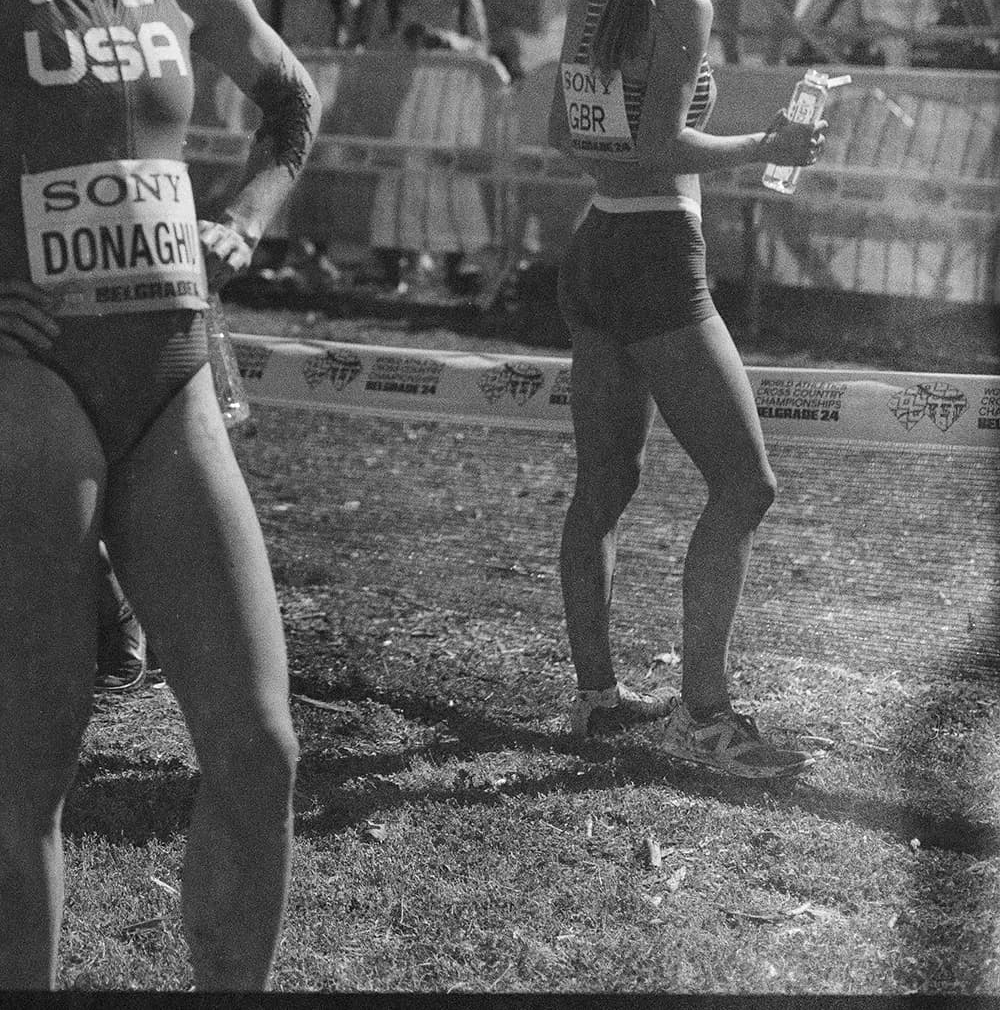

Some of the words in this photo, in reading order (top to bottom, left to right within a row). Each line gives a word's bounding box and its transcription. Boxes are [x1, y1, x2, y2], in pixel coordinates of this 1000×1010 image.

[24, 21, 188, 85] USA
[564, 71, 613, 94] SONY
[569, 103, 606, 133] GBR
[42, 174, 180, 213] SONY
[755, 396, 841, 409] CHAMPIONSHIPS
[757, 388, 790, 396] CROSS
[793, 389, 844, 398] COUNTRY
[821, 409, 839, 422] 24
